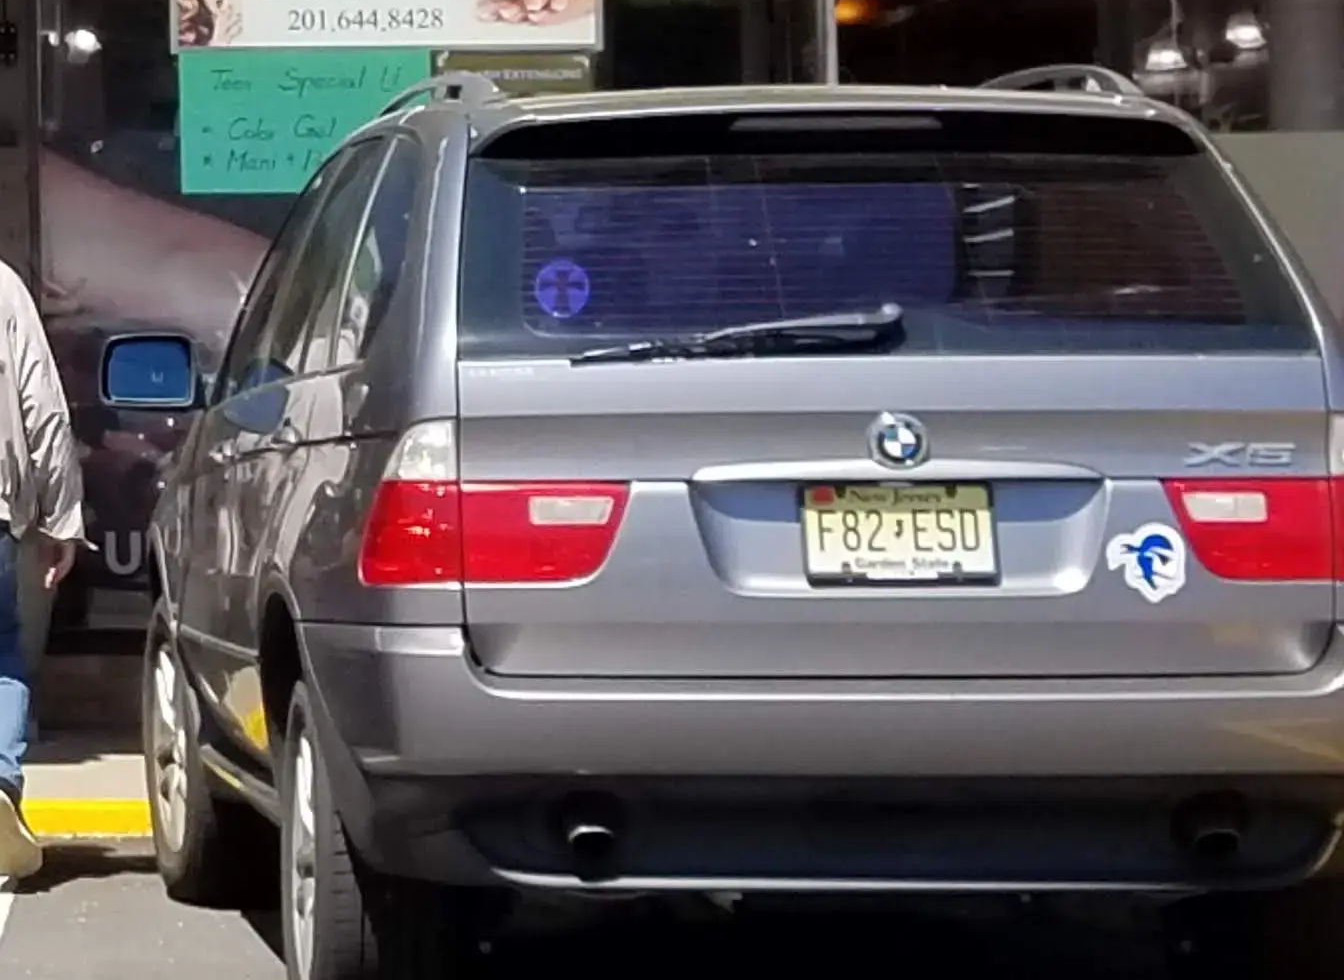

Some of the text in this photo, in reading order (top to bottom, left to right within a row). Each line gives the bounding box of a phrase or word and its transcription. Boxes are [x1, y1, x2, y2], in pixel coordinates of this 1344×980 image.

[287, 8, 444, 32] 201.644.8428
[277, 66, 366, 98] Special
[1183, 442, 1296, 467] X5
